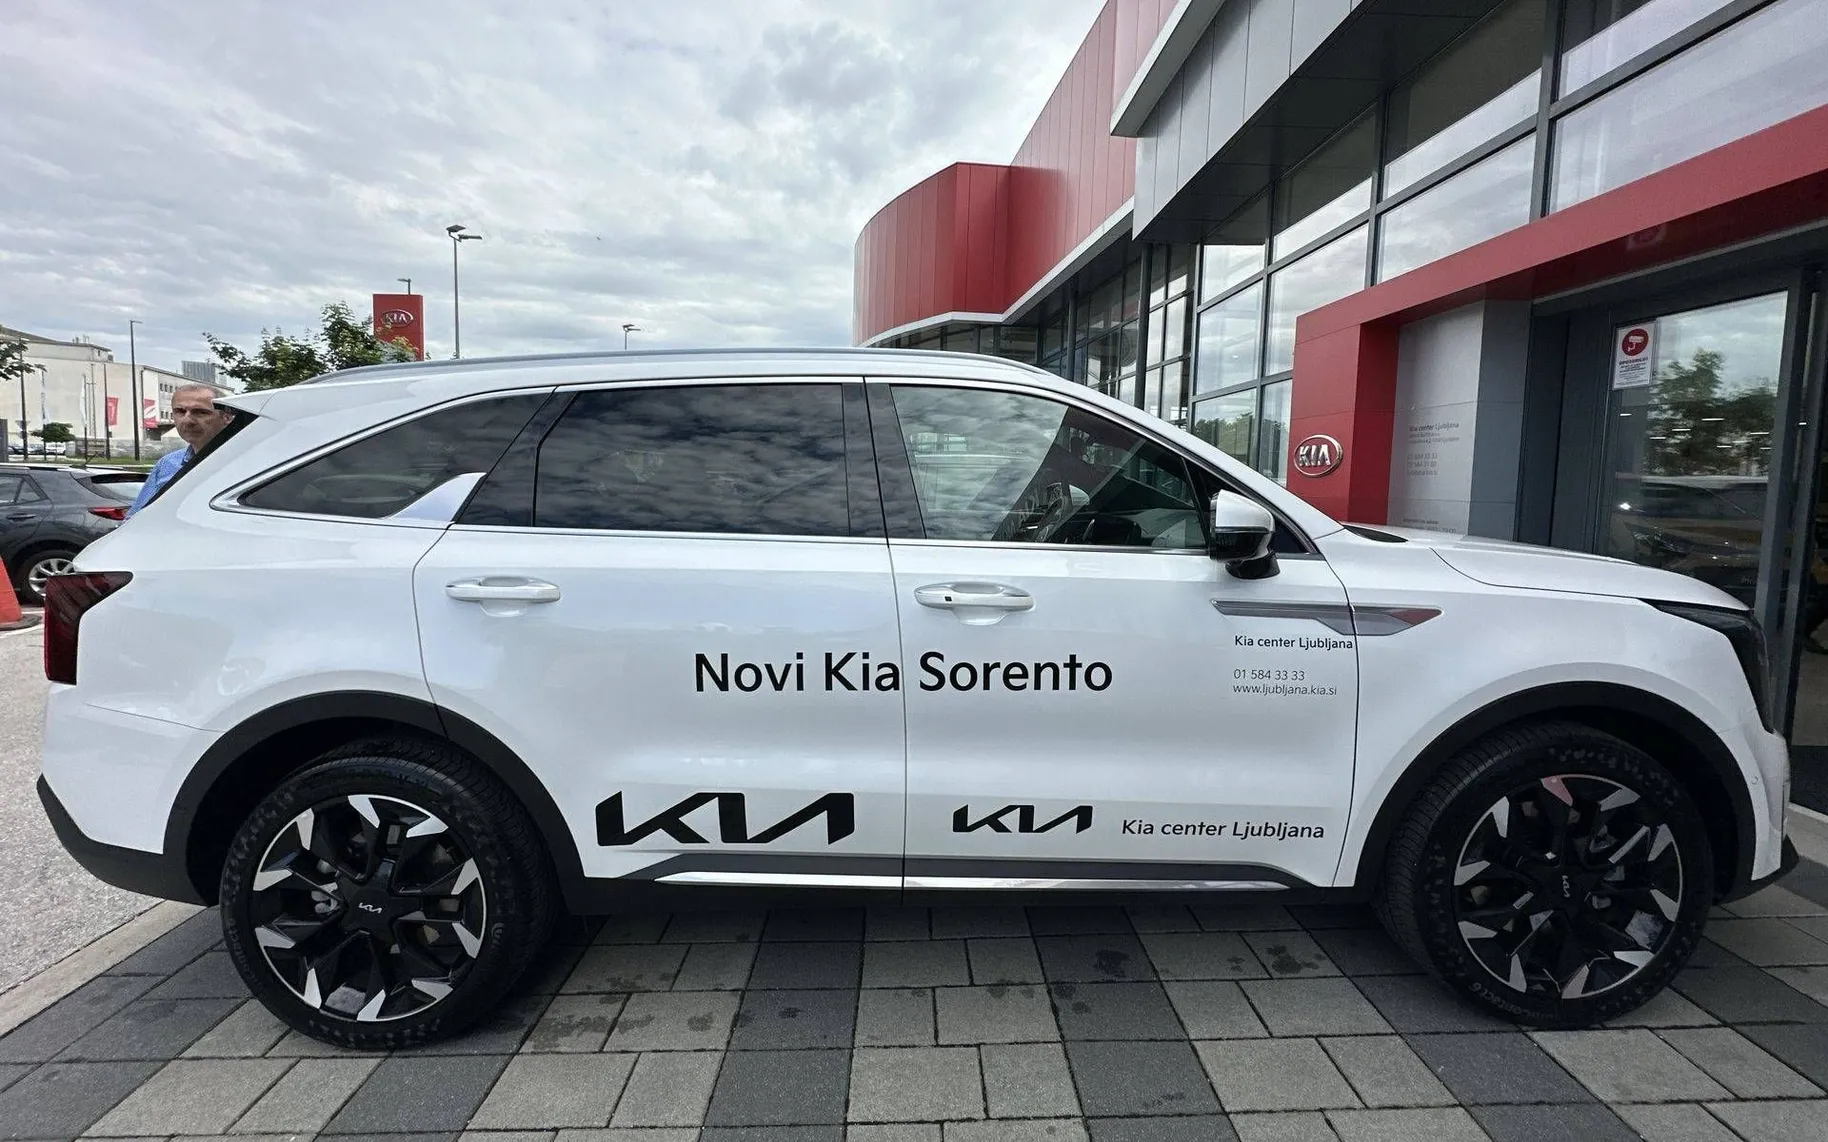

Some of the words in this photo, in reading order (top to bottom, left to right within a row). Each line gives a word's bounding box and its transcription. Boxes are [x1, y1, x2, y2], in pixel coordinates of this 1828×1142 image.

[1299, 444, 1331, 467] KIA
[1234, 635, 1254, 647] Kia
[1257, 637, 1295, 648] center
[1299, 637, 1353, 650] Ljubljana
[695, 652, 804, 692] Novi
[824, 652, 900, 692] Kia
[919, 651, 1113, 692] Sorento
[1233, 669, 1246, 680] 01
[1251, 669, 1271, 680] 584
[1275, 670, 1288, 681] 33
[1291, 670, 1305, 681] 33
[1233, 683, 1337, 697] www.ljubljana.kia.si
[595, 790, 855, 846] KIA
[952, 804, 1093, 834] KIA
[1122, 819, 1154, 836] Kia
[1161, 820, 1227, 837] center
[1232, 821, 1325, 840] Ljubljana
